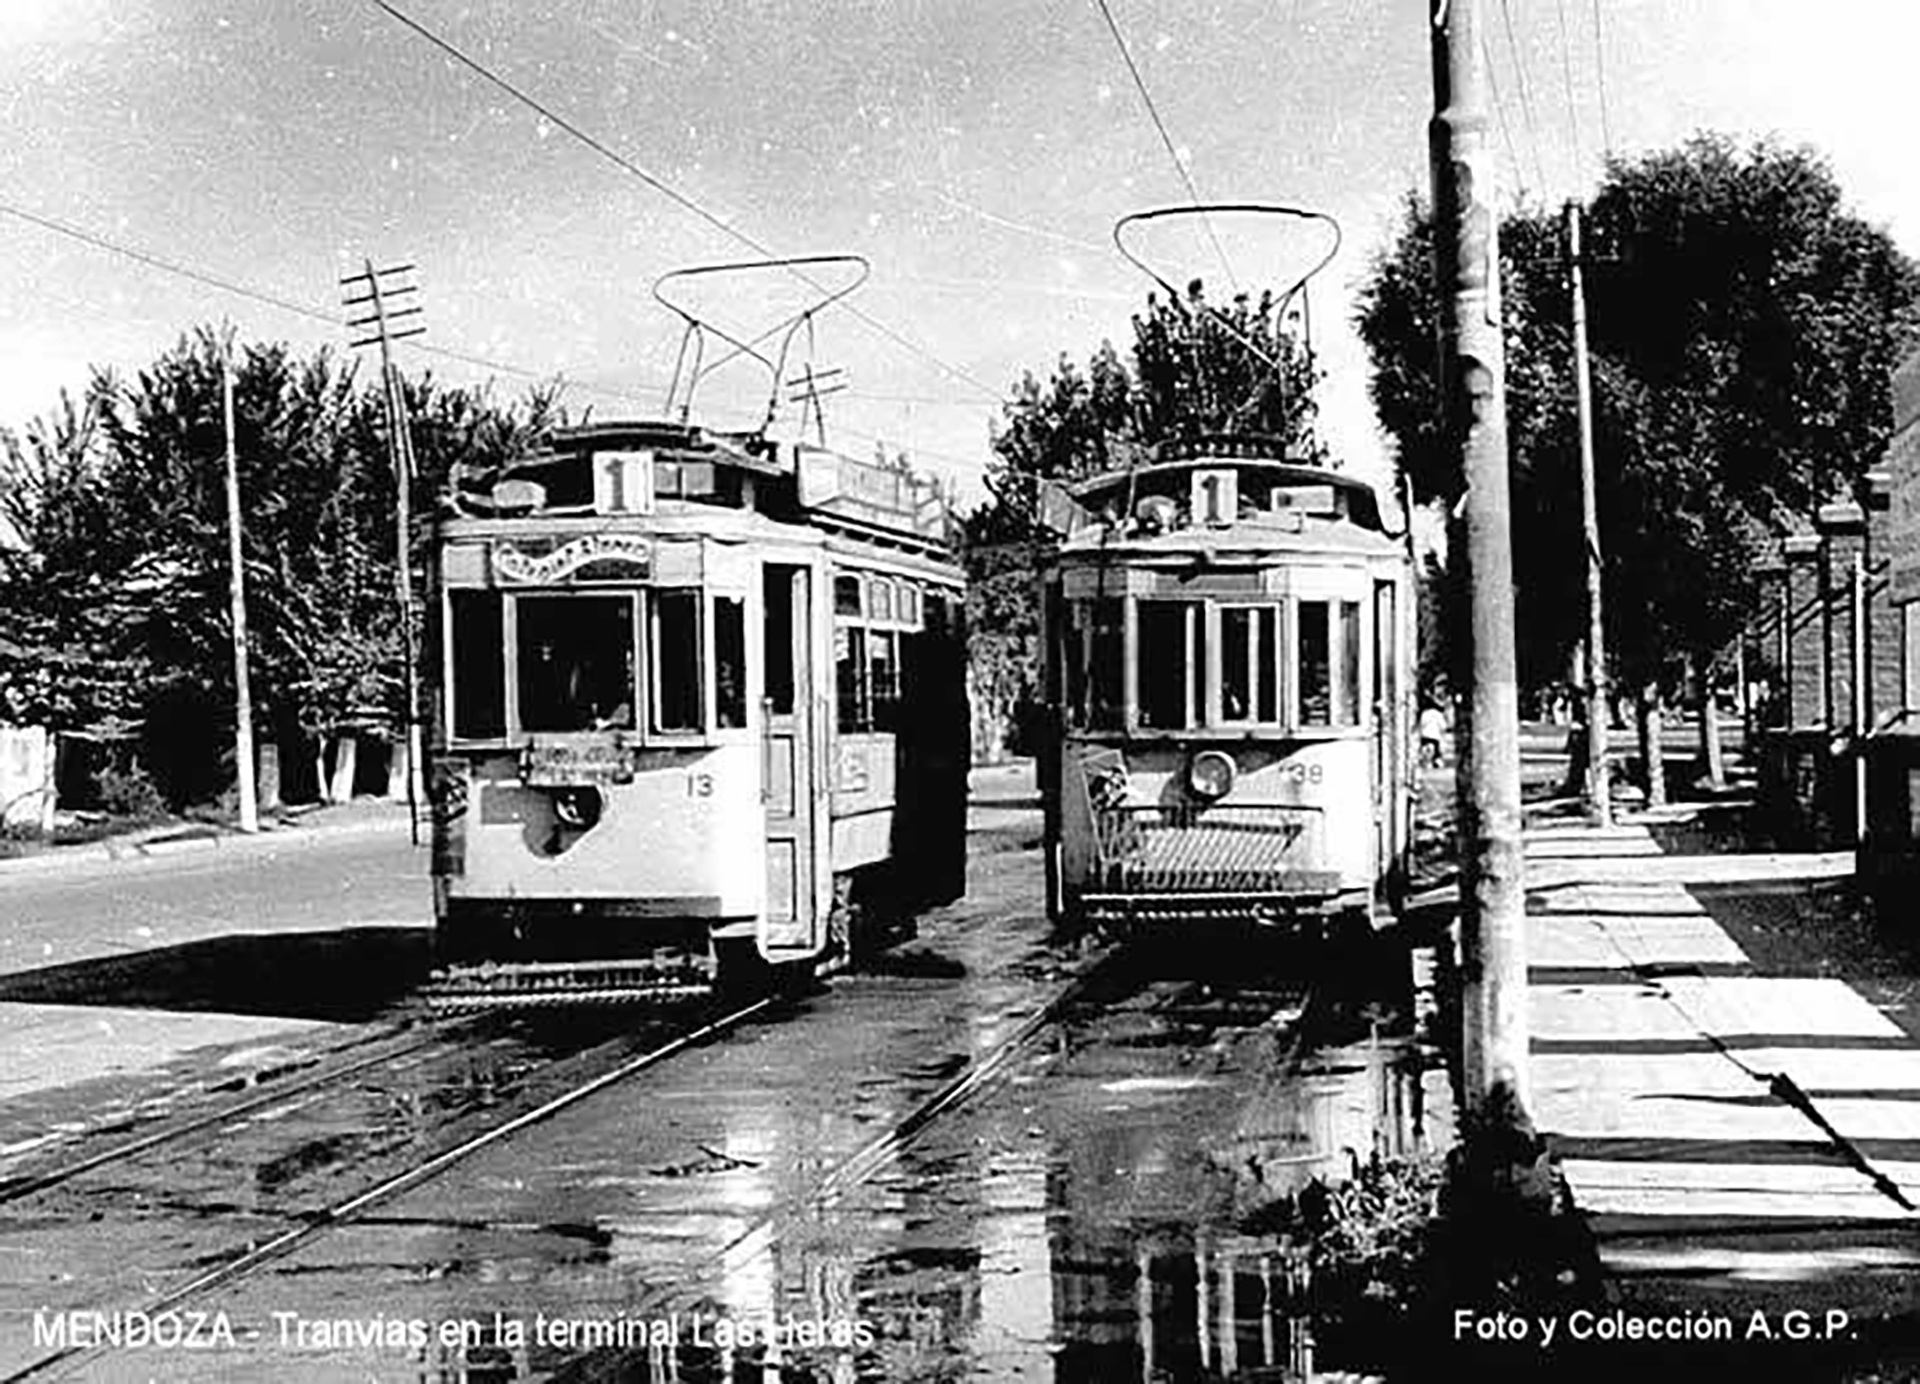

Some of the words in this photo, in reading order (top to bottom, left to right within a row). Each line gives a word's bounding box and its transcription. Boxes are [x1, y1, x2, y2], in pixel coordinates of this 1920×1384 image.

[604, 458, 628, 511] 1
[1201, 474, 1222, 522] 1
[687, 774, 713, 797] 13
